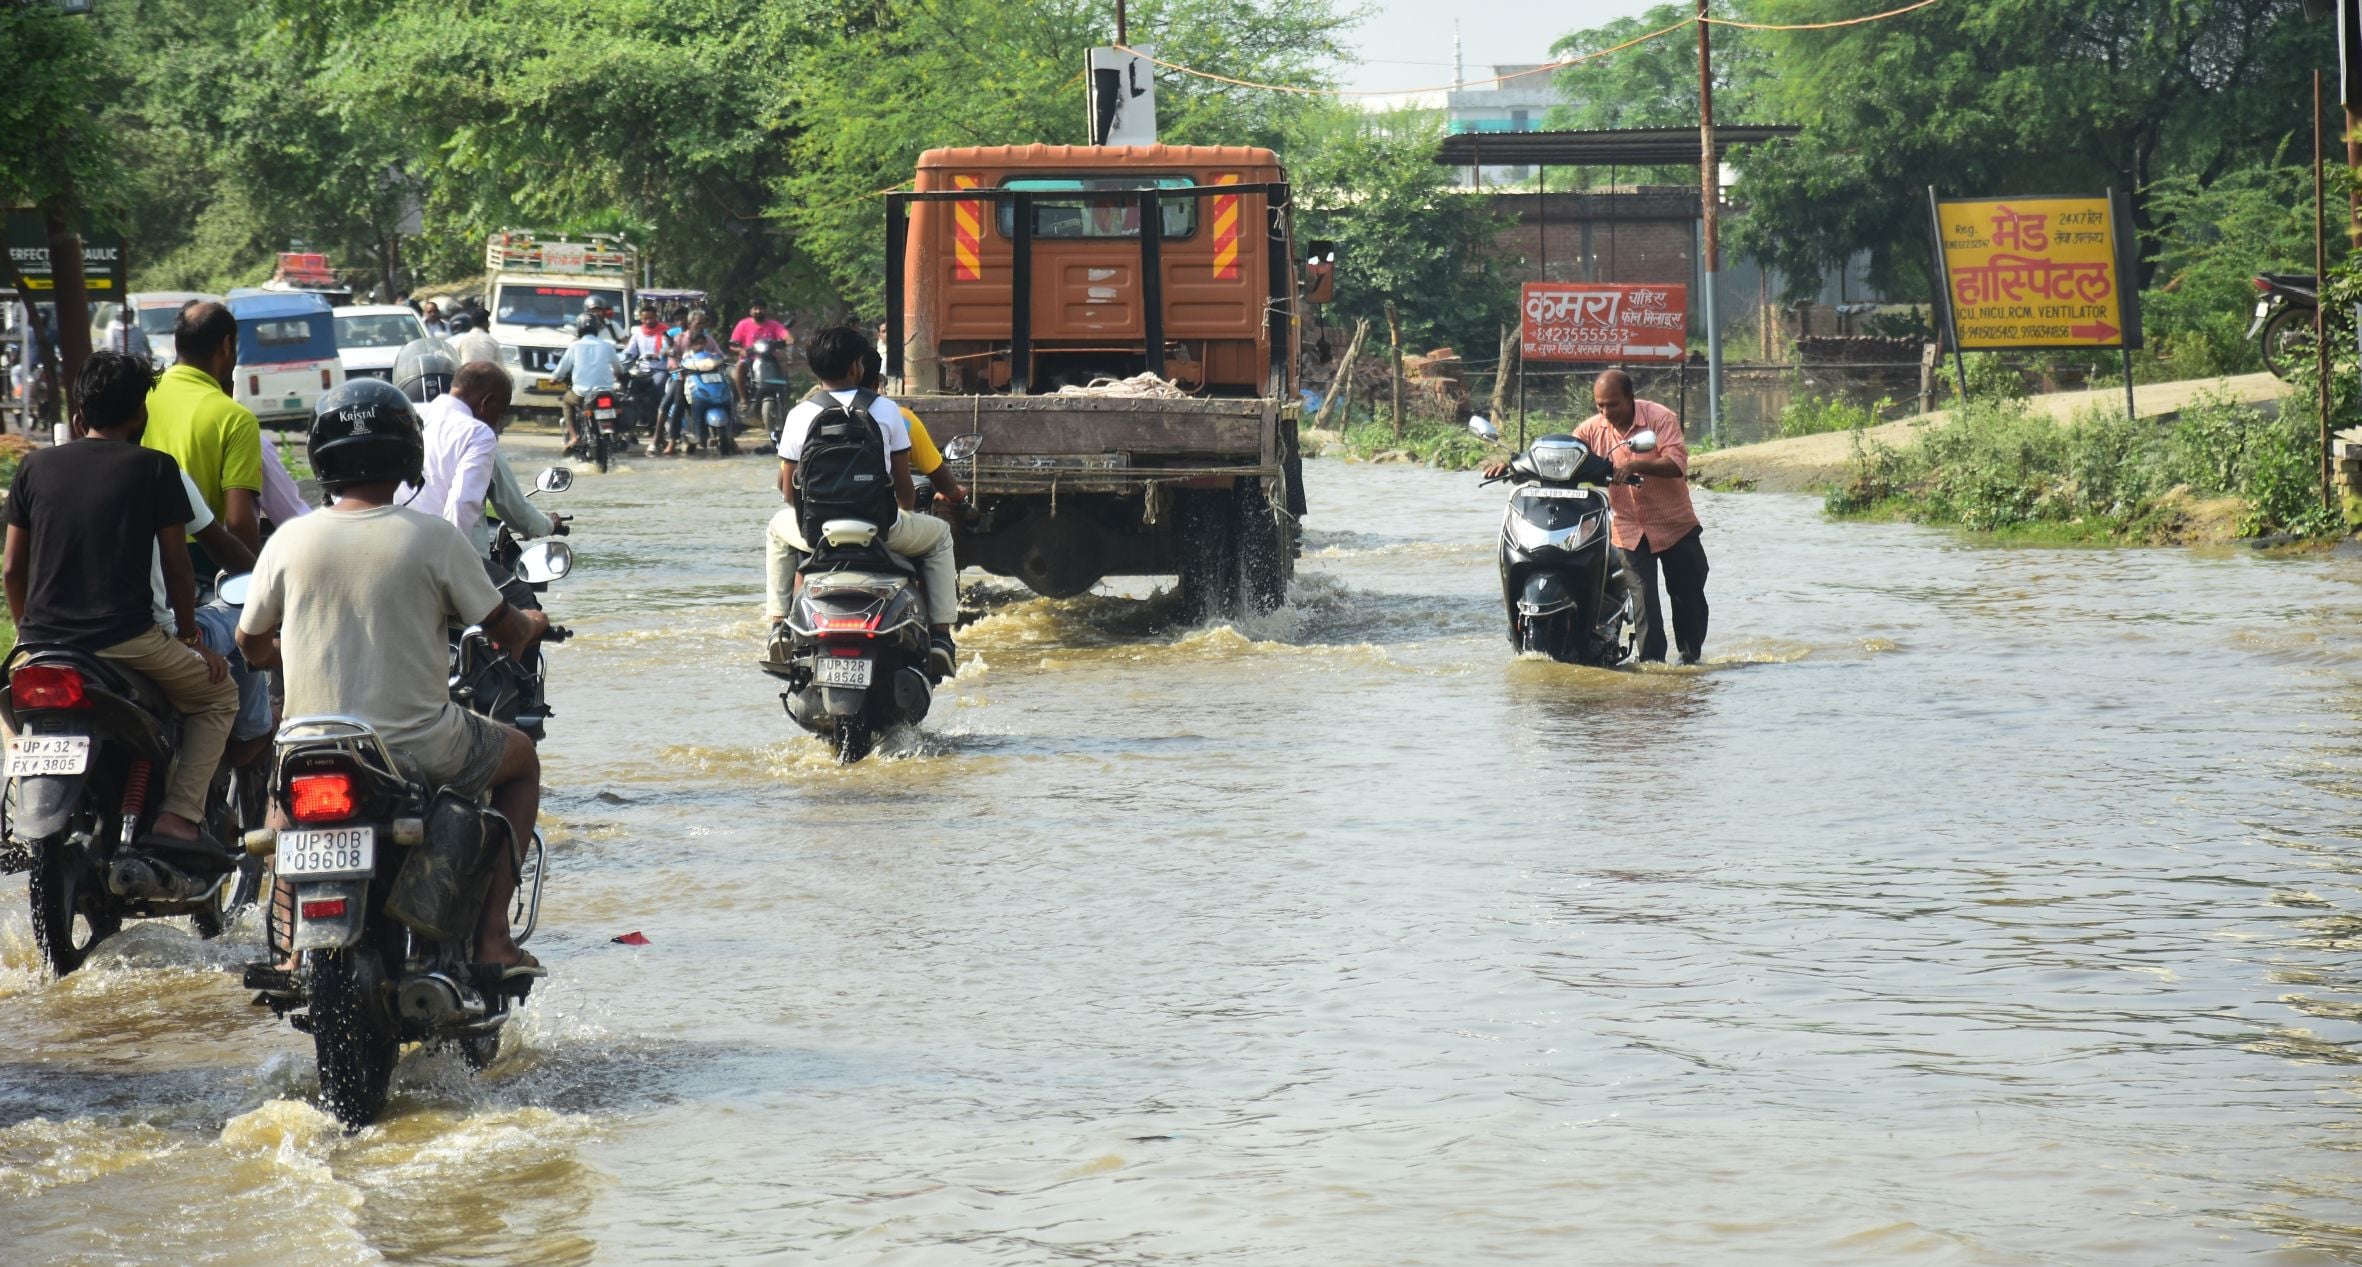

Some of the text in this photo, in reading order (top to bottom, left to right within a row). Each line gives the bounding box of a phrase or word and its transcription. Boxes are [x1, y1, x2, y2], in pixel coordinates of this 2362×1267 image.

[2059, 213, 2086, 225] 24X7
[1990, 205, 2048, 252] मेड
[9, 247, 118, 260] ERFECT AULIC
[1525, 291, 1623, 327] कमरा
[2038, 304, 2108, 320] VENTILATOR
[826, 659, 866, 672] UP32R
[826, 671, 865, 684] A8548
[23, 740, 70, 754] UP 32
[12, 758, 76, 774] FX 3805
[295, 831, 362, 852] UP30B
